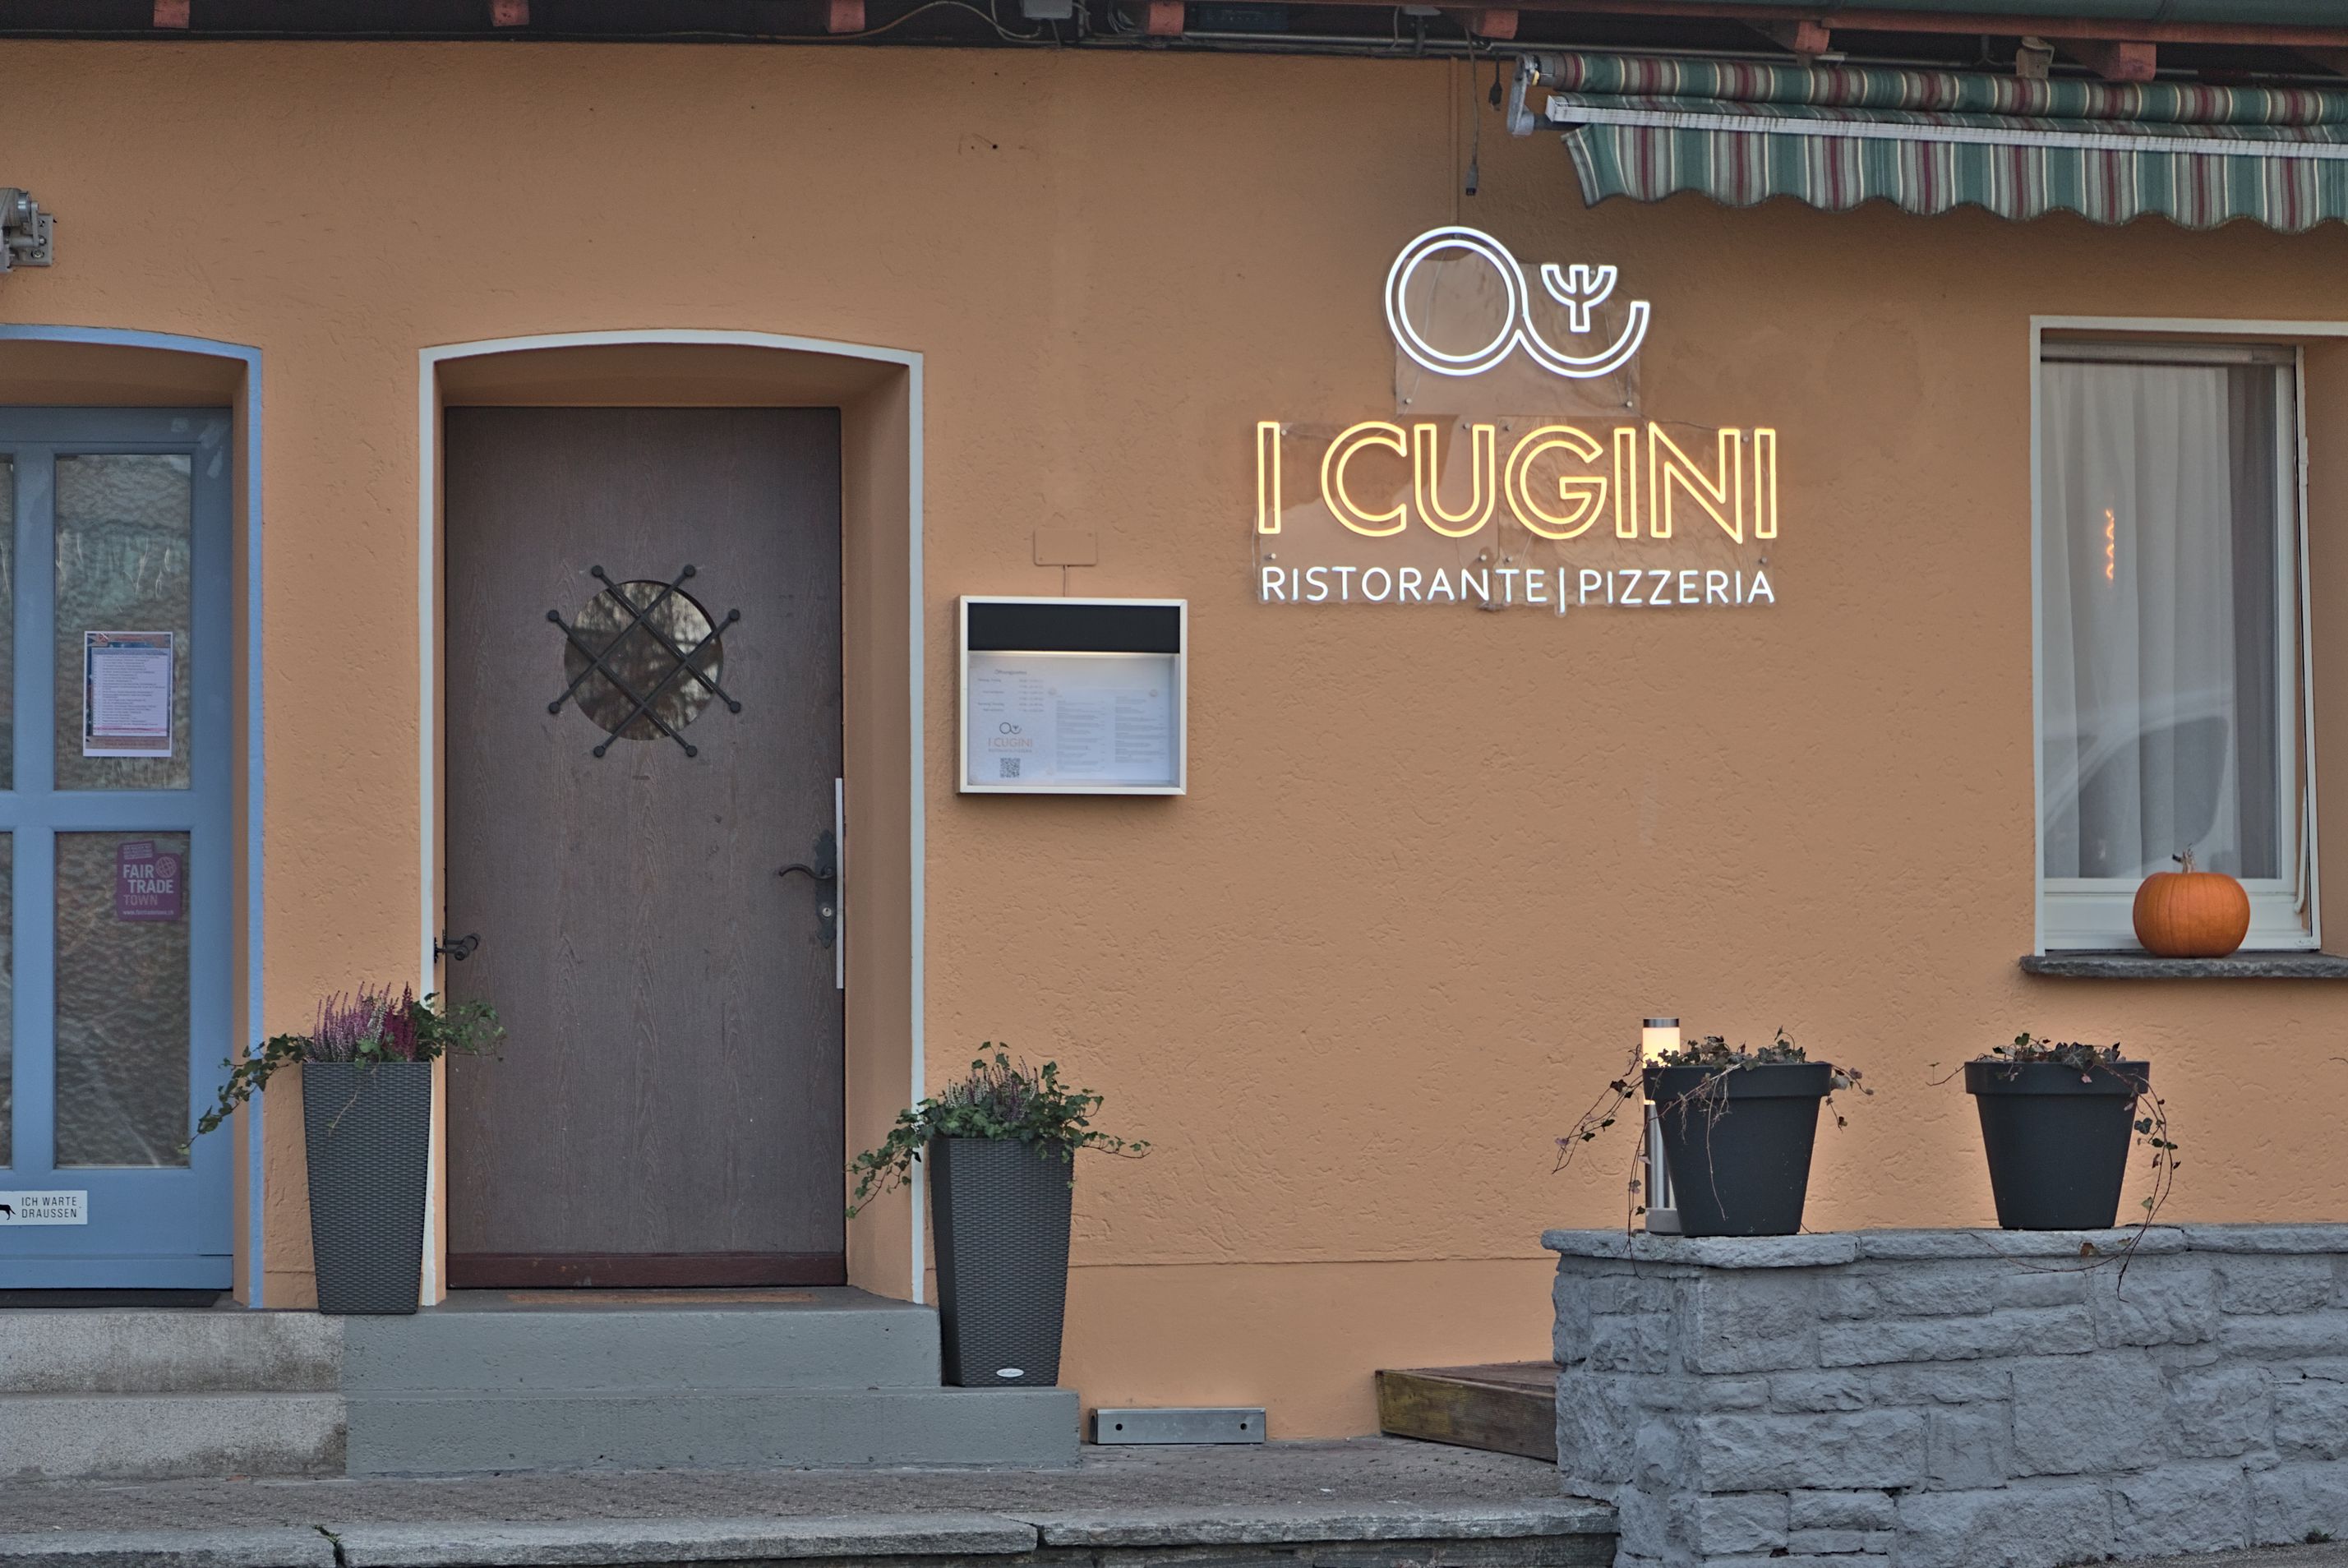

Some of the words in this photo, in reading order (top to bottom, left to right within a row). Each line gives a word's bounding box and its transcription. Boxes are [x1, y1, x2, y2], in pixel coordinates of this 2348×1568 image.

[1257, 421, 1281, 535] I
[1320, 420, 1778, 544] CUGINI
[993, 737, 1033, 748] CUGINI
[123, 864, 155, 879] FAIR
[127, 879, 174, 894] TRADE
[123, 894, 158, 906] TOWN
[21, 1197, 38, 1206] ICH
[42, 1197, 77, 1206] WARTE
[21, 1208, 77, 1218] DRAUSSEN
